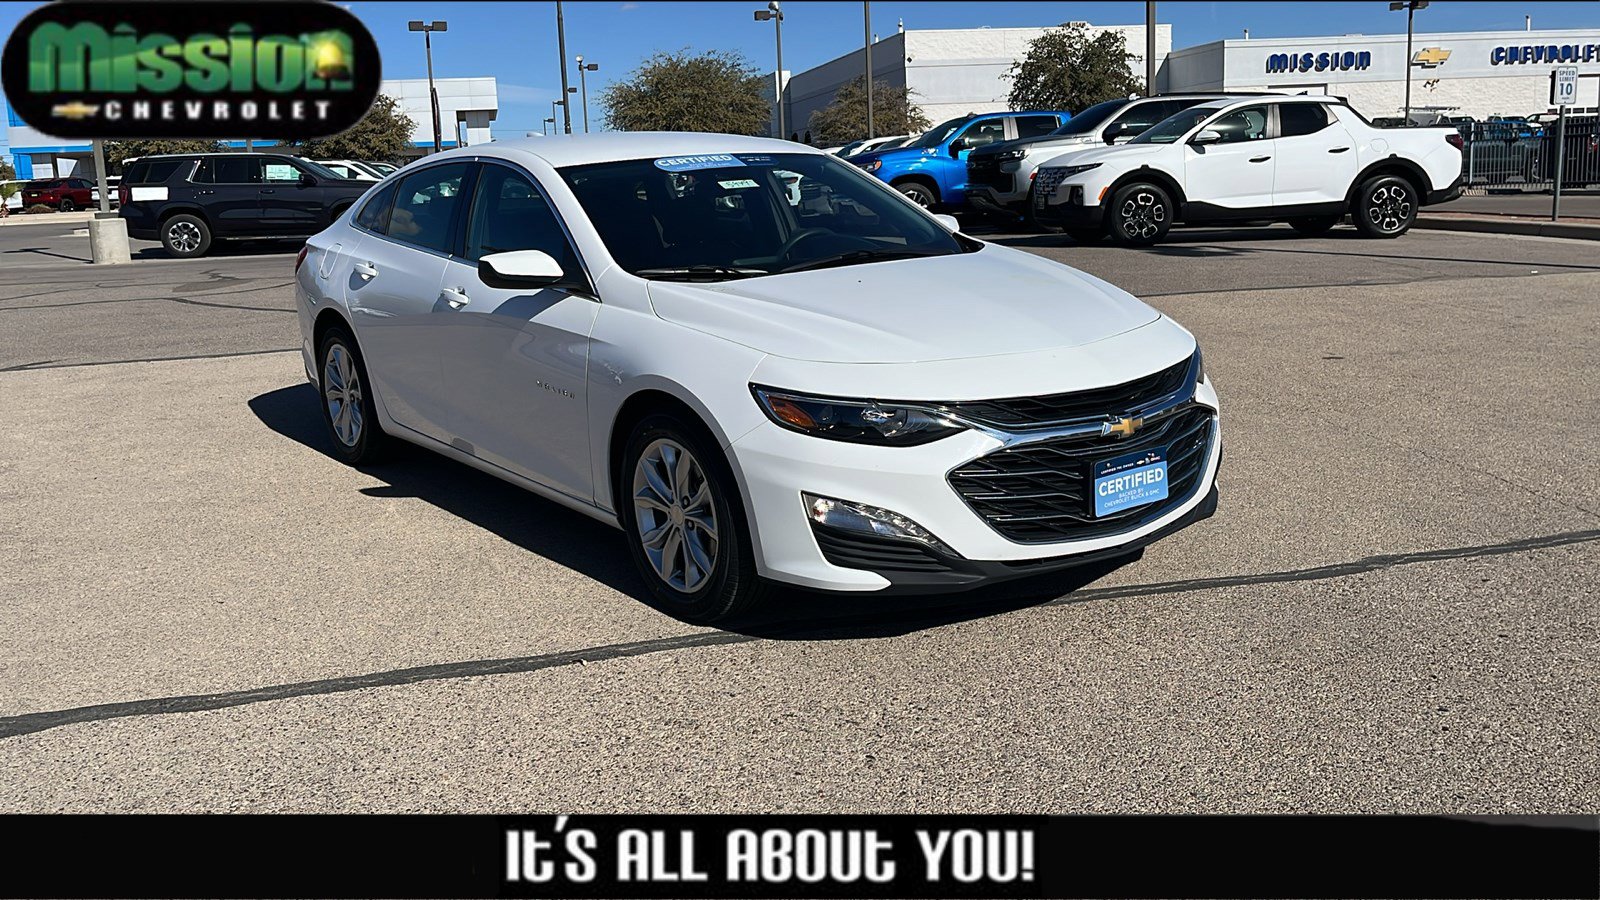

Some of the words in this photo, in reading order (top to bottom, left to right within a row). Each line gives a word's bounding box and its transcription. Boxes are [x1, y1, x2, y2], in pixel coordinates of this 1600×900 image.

[1265, 51, 1371, 74] MISSION
[1490, 44, 1600, 66] CHEVROLE
[1559, 83, 1573, 96] 10
[657, 154, 733, 167] CERTIFIED
[1098, 467, 1164, 497] CERTIFIED
[1118, 489, 1137, 498] BACKED
[1103, 497, 1130, 508] CHEVROLET
